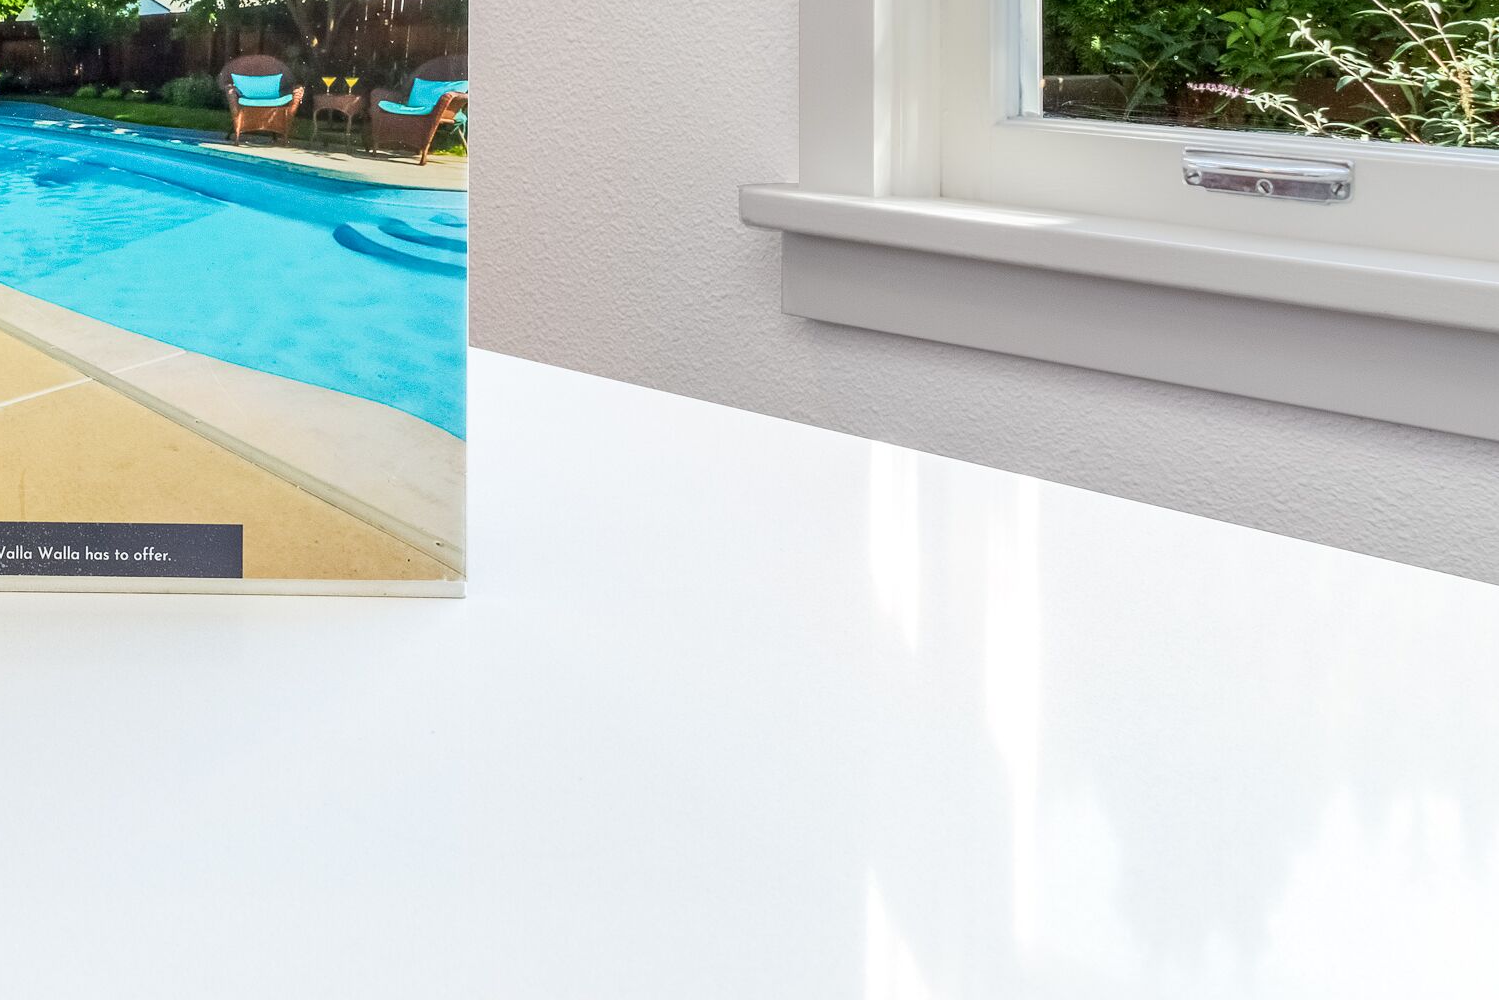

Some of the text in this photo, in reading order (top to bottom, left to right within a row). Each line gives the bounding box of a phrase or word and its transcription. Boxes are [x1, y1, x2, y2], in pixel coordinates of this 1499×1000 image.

[37, 545, 80, 560] Walla
[85, 545, 110, 561] has
[114, 548, 129, 561] to
[133, 546, 172, 561] offer.
